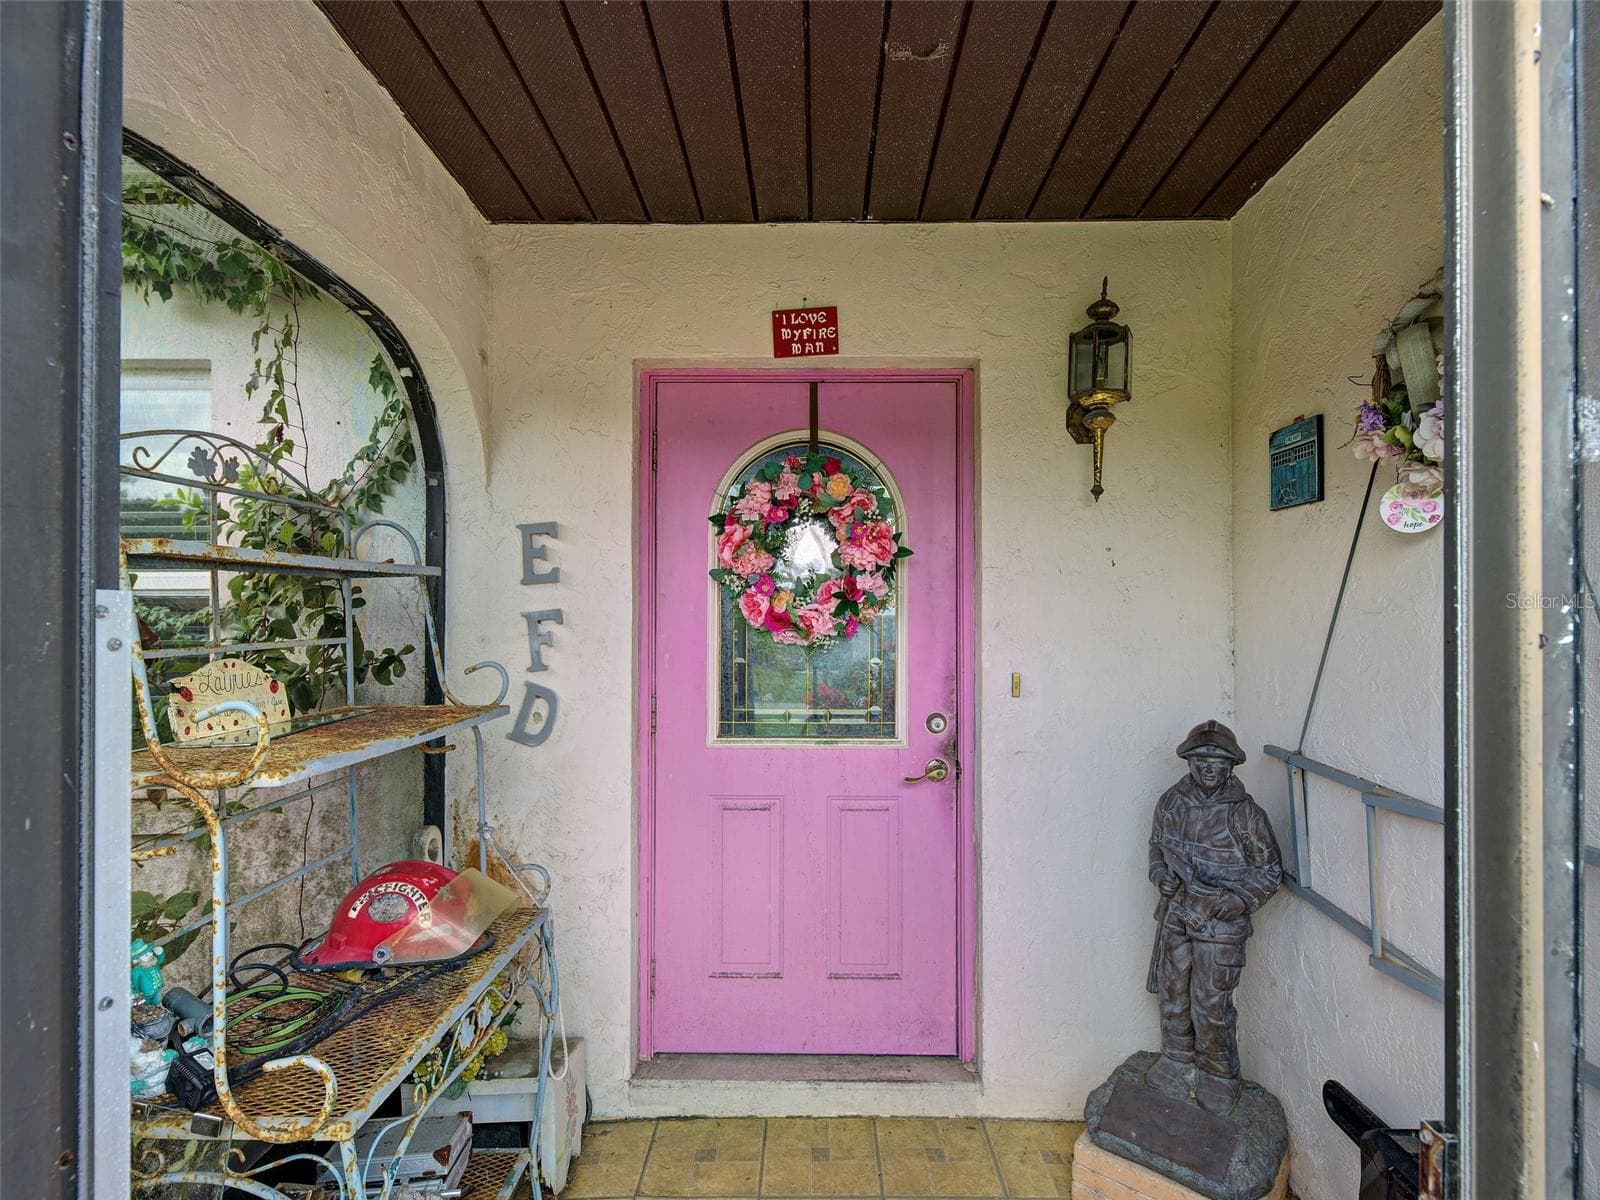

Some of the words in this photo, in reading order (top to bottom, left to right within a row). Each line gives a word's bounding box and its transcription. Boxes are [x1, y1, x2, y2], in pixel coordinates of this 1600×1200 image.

[782, 314, 787, 325] I
[791, 311, 827, 325] LOVE
[791, 342, 824, 354] MAN
[1403, 521, 1424, 530] hope
